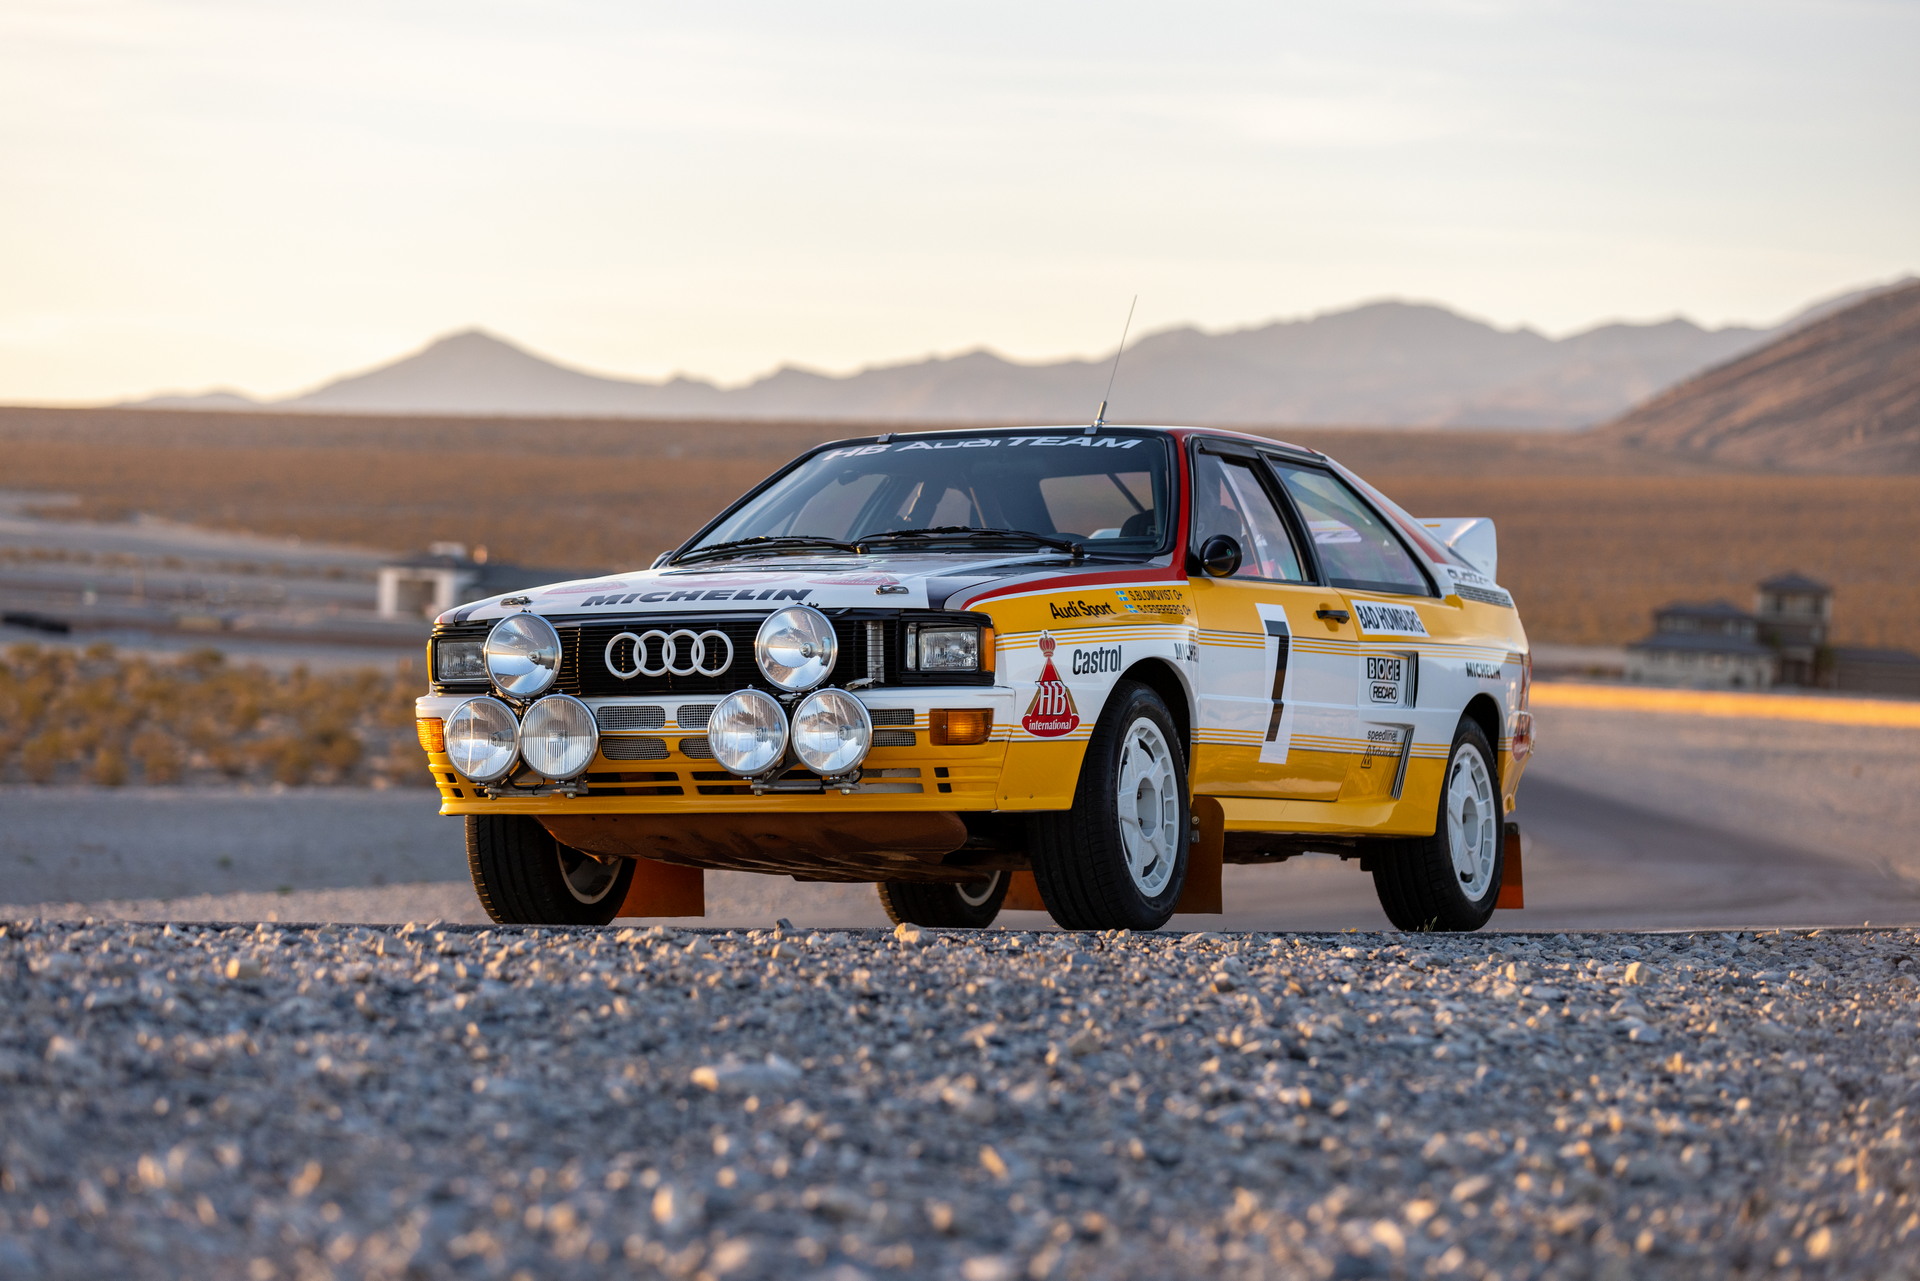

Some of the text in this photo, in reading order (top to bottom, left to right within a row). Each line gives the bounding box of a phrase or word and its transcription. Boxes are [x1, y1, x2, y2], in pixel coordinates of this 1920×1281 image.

[822, 444, 892, 461] HB
[1008, 436, 1143, 449] TEAM
[580, 589, 814, 607] MICHELIN
[1050, 600, 1117, 619] Audi Sport
[1355, 605, 1426, 633] BAD HOMBURG
[1072, 645, 1122, 675] Castrol
[1368, 658, 1400, 681] BOGE
[1466, 662, 1501, 680] MICHELIN
[1264, 619, 1290, 742] 7
[1035, 680, 1067, 716] HB
[1372, 685, 1398, 700] RECARO
[1028, 718, 1072, 730] international
